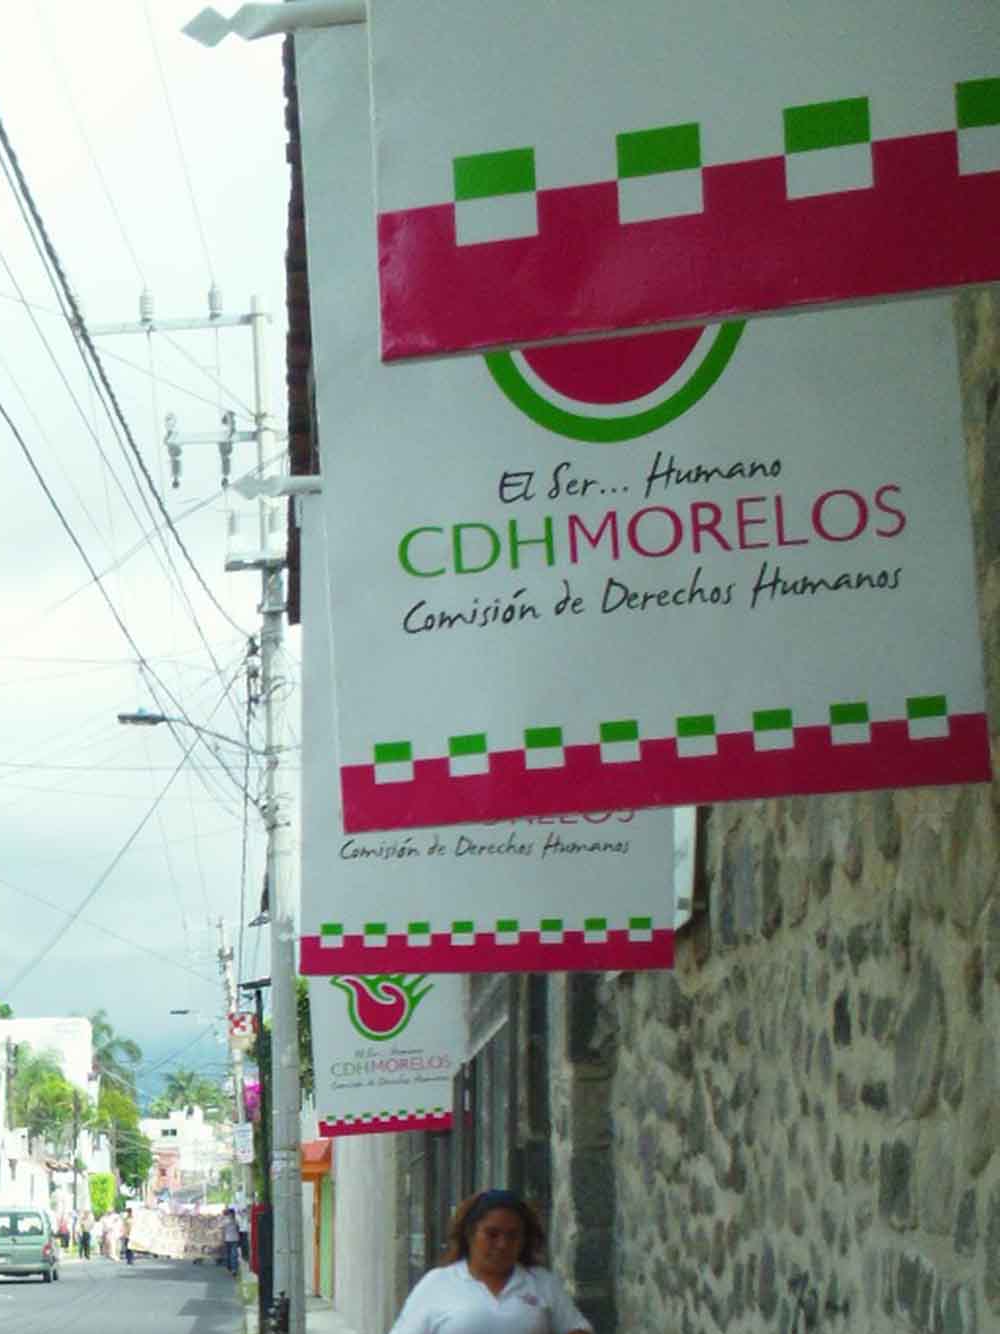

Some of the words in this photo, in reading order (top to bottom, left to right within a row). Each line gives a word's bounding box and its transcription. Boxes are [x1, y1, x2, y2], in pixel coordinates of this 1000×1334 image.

[498, 470, 537, 504] El
[644, 450, 782, 499] Humano
[397, 483, 907, 579] CDHMORELOS
[402, 587, 542, 634] Comisión
[554, 578, 586, 616] de
[601, 566, 736, 615] Derechos
[750, 560, 903, 609] Humanos
[338, 836, 421, 861] Comisión
[427, 833, 447, 857] de
[454, 831, 533, 857] Derechos
[540, 830, 631, 860] Humanos
